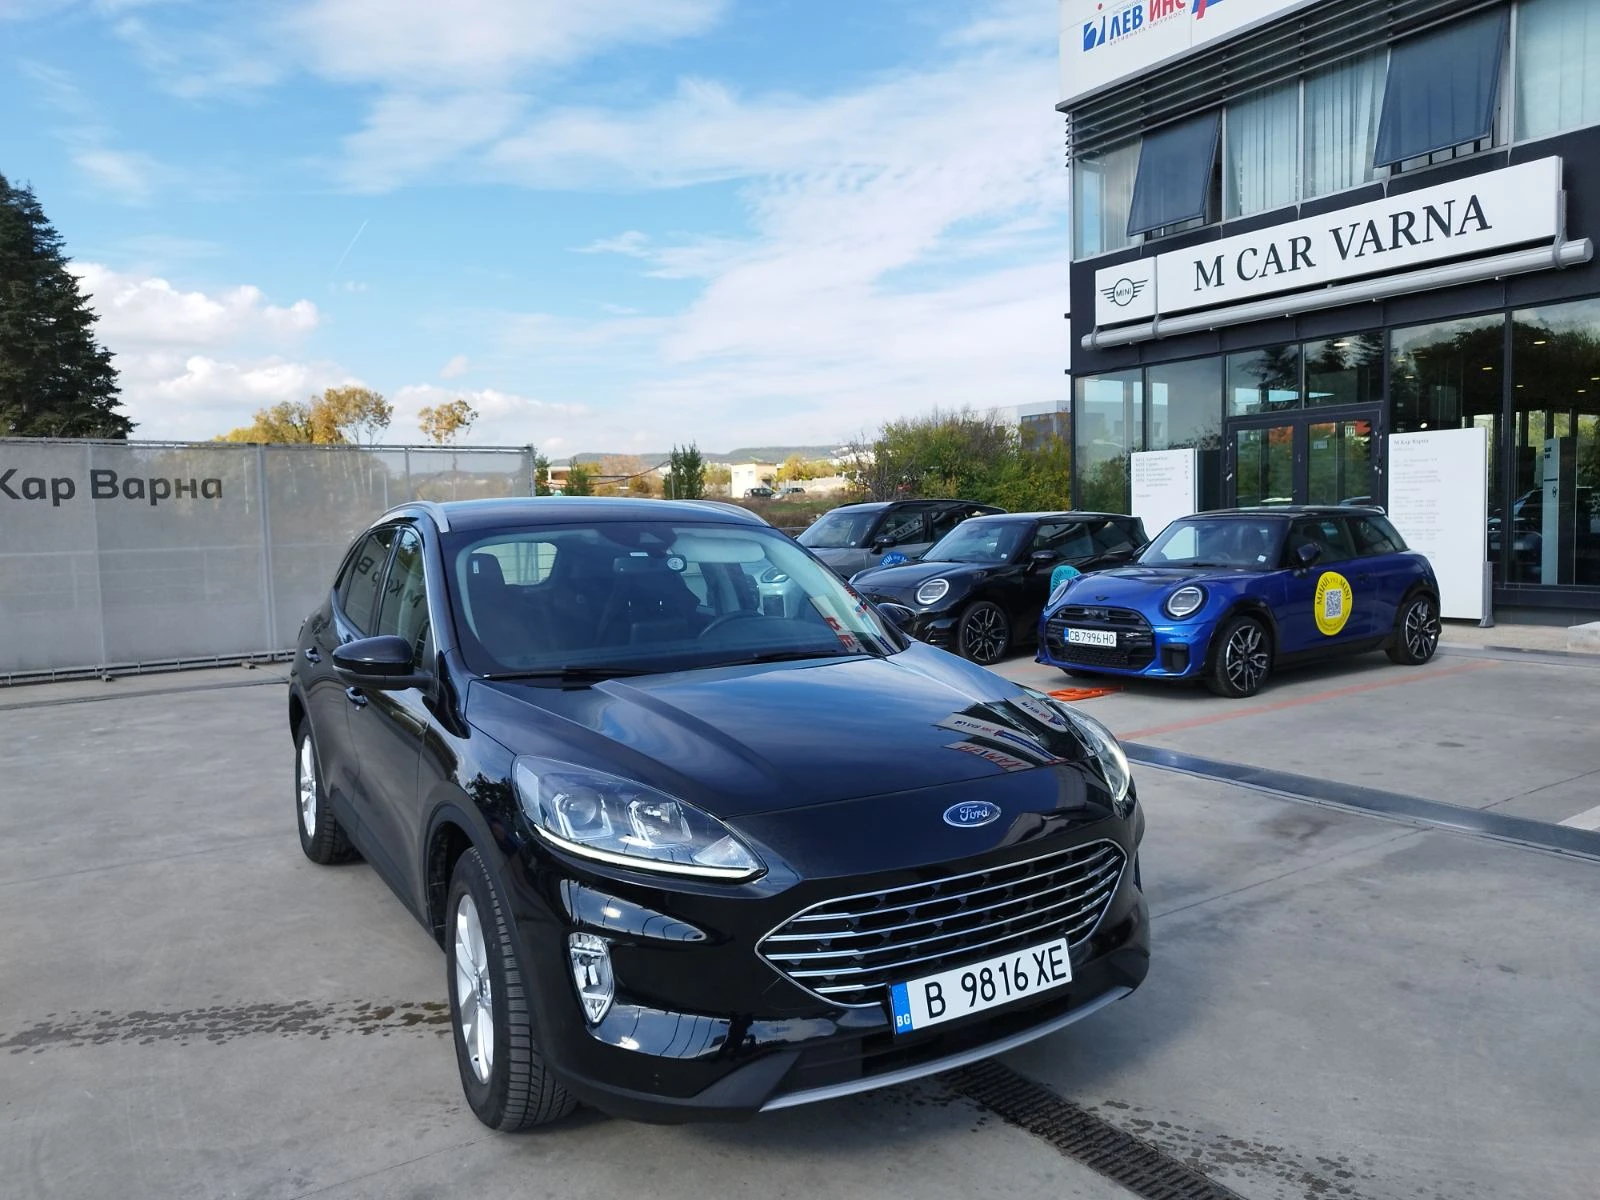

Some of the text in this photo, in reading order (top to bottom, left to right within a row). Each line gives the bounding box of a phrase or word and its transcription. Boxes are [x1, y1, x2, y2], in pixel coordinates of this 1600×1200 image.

[1110, 5, 1143, 40] ЛЕВ
[1193, 195, 1492, 291] M CAR VARNA
[1116, 287, 1132, 298] MINI
[90, 469, 223, 506] Варна
[1081, 632, 1102, 644] 7996
[960, 804, 991, 822] Ford
[924, 944, 1067, 1019] B 9816 XE
[896, 1013, 911, 1027] BG
